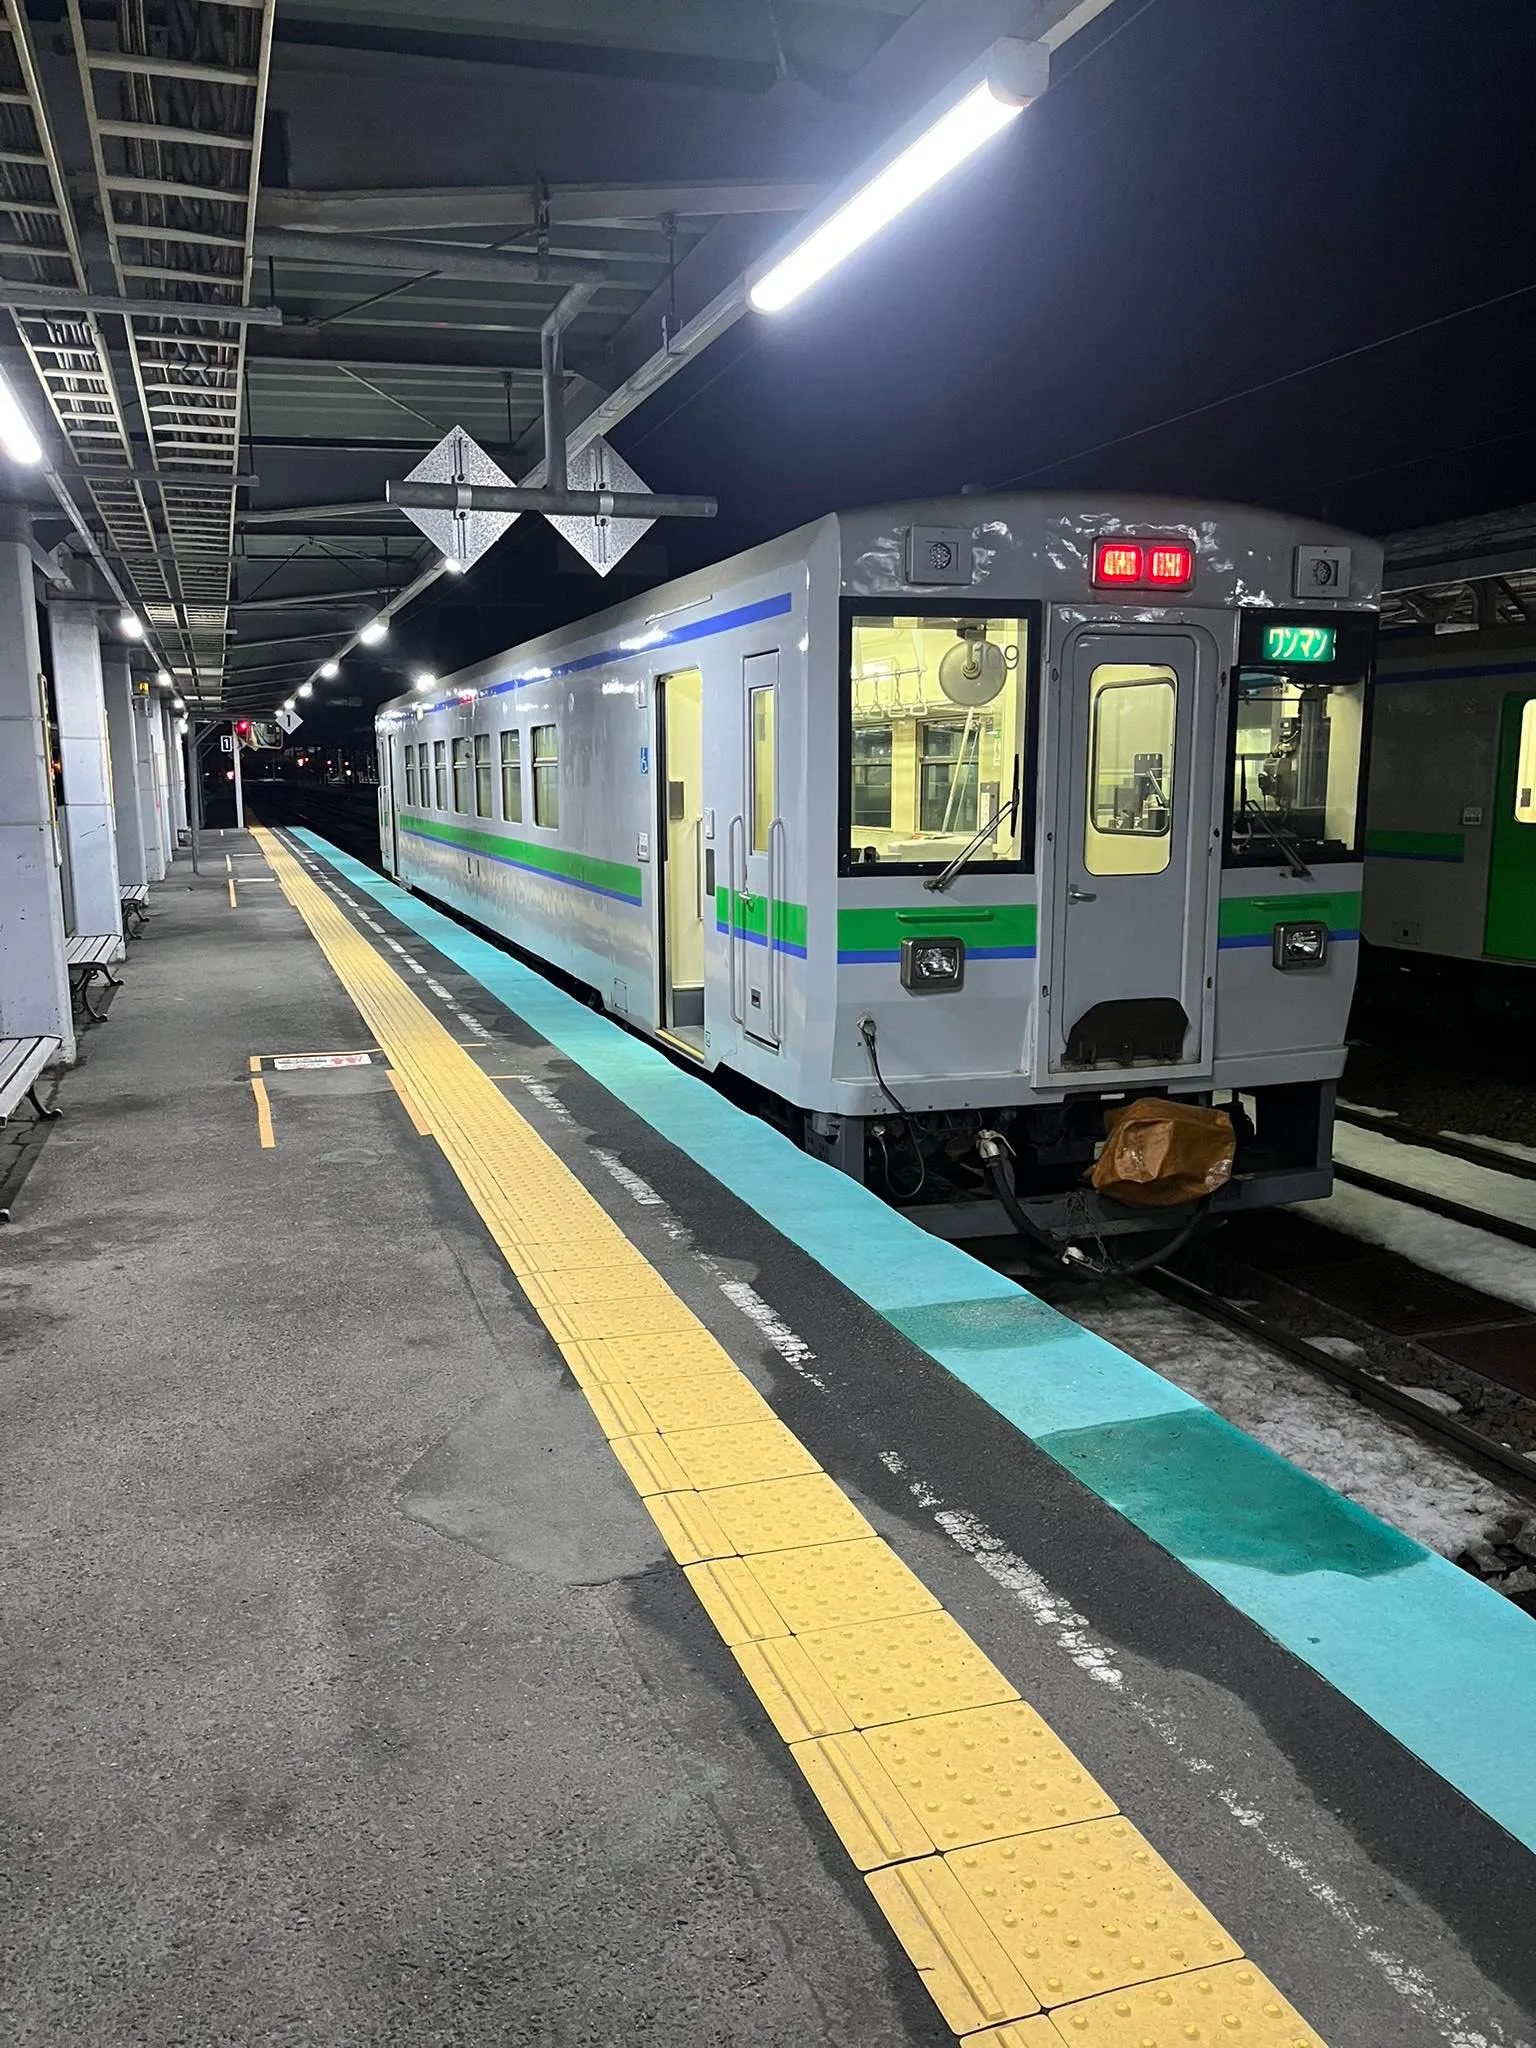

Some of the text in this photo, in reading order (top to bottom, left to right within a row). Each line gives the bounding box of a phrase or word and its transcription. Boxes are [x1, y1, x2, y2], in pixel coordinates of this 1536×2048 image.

[974, 643, 1020, 670] 109
[1269, 628, 1328, 659] ワンマン
[286, 714, 292, 727] 1
